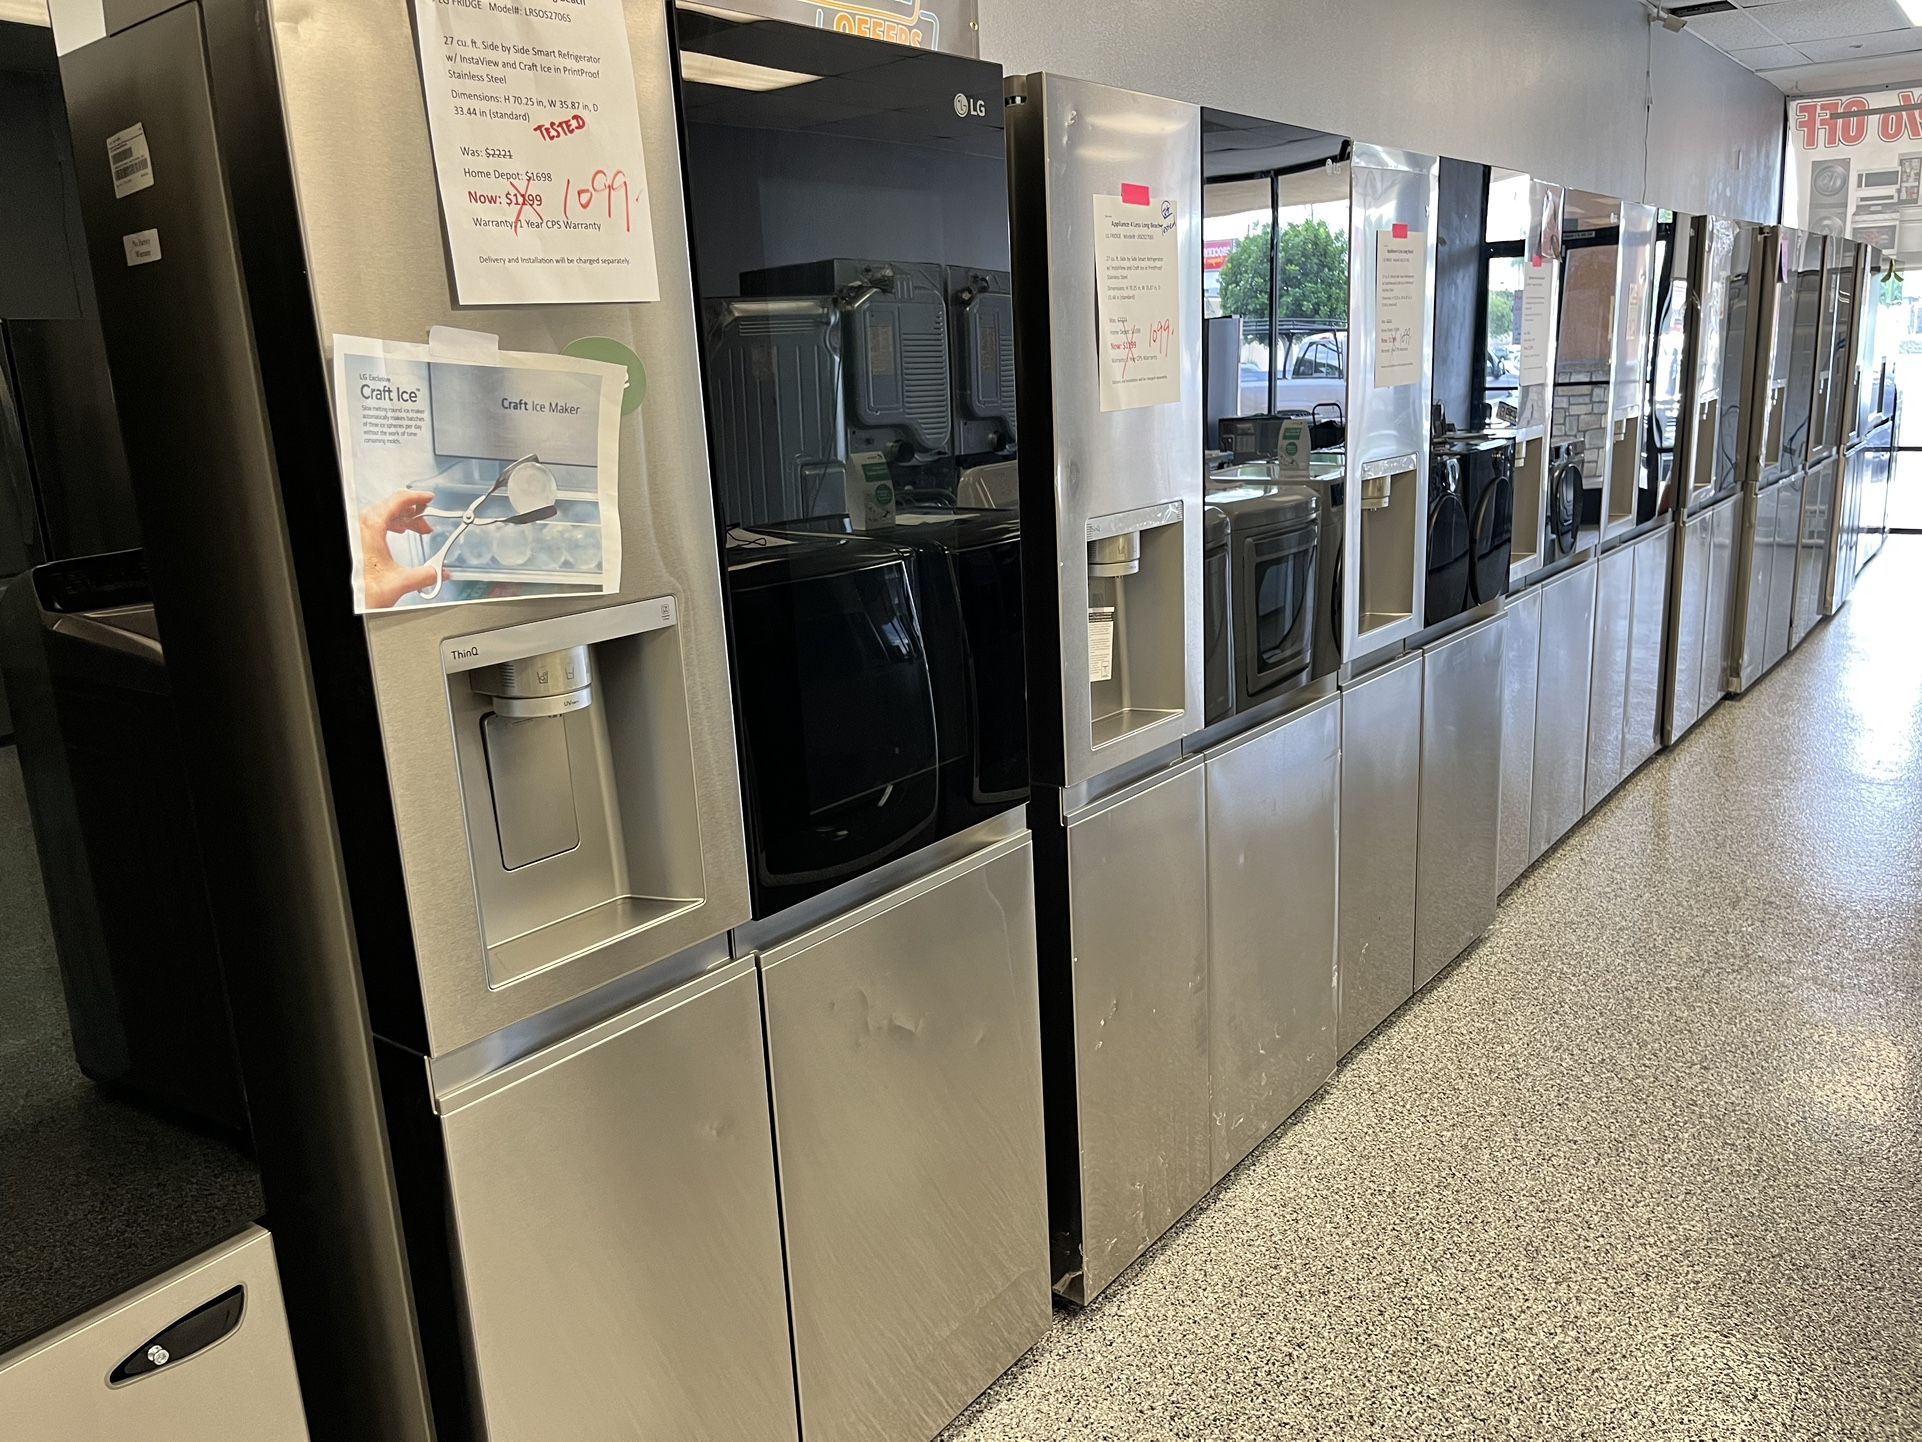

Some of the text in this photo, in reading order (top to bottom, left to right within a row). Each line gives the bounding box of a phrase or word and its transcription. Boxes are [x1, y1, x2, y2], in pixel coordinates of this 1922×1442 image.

[488, 3, 523, 15] Model#:
[524, 8, 572, 23] LRSOS2706S
[444, 36, 600, 64] 27 cu. ft. Side by Side Smart Refrigerator
[446, 53, 600, 79] w/ InstaView and Craft Ice in PrintProof
[448, 70, 506, 84] Stainless Steel
[451, 90, 598, 113] Dimensions: H 70.25 in, W 35.87 in, D
[970, 98, 986, 117] LG
[454, 106, 530, 122] 33.44 in (standard)
[460, 147, 483, 157] Was:
[464, 168, 552, 182] Home Depot: $1698
[468, 191, 502, 205] Now:
[525, 219, 543, 229] Year
[546, 220, 561, 229] CPS
[563, 220, 601, 231] Warranty
[479, 256, 506, 264] Delivery
[576, 257, 599, 266] charged
[360, 384, 393, 401] Craft
[501, 398, 580, 415] Craft Ice Maker
[450, 646, 480, 661] ThinQ
